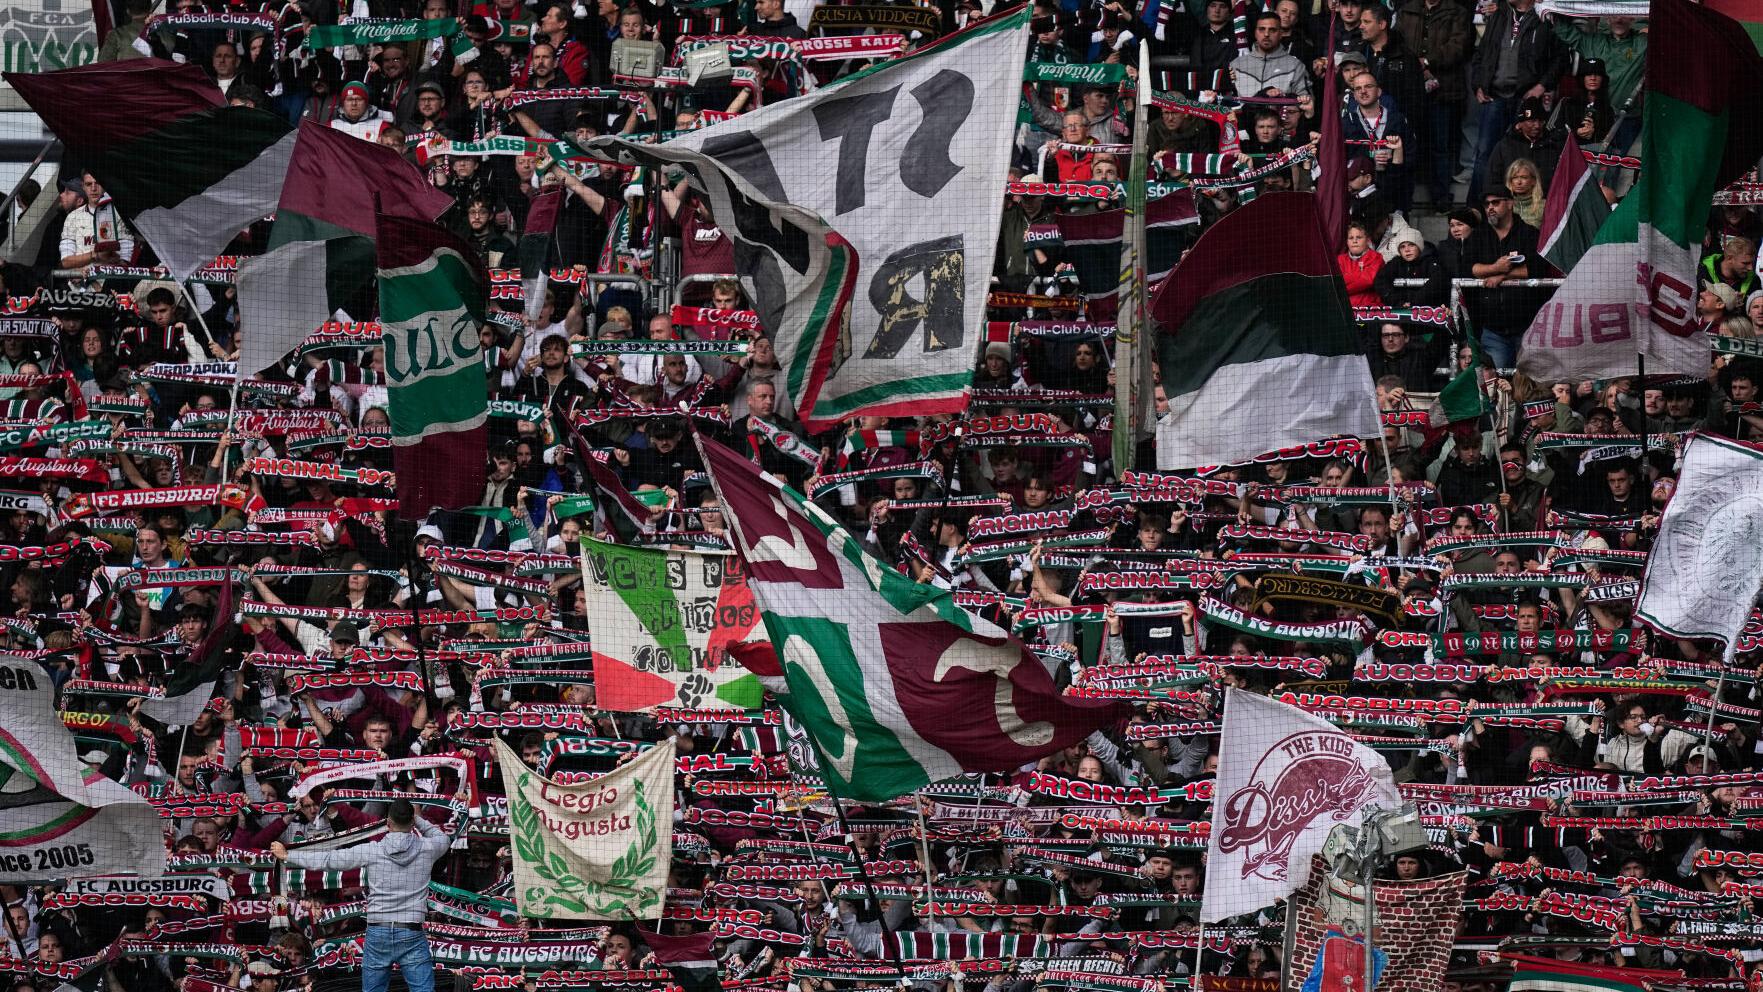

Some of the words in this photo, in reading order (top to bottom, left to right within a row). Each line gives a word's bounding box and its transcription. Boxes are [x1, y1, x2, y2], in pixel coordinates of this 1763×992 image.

[168, 14, 249, 26] Fußball-Club
[813, 9, 863, 21] GUSTA
[352, 21, 418, 41] Mitglied
[1037, 63, 1107, 83] Mitglied
[697, 309, 716, 323] FC
[14, 321, 41, 336] STADT
[203, 411, 229, 423] SIND
[982, 435, 1006, 447] DER
[9, 457, 89, 476] Augsburg
[97, 496, 120, 509] FC
[122, 487, 217, 507] AUGSBURG
[1334, 487, 1383, 498] AUGSBURG
[972, 544, 1000, 558] SIND
[519, 562, 545, 573] SIND
[548, 561, 573, 572] DER
[118, 573, 142, 587] FC
[245, 602, 270, 615] WIR
[271, 605, 301, 617] SIND
[302, 608, 329, 619] DER
[1023, 605, 1073, 626] SIND
[1075, 605, 1098, 621] 2.
[1249, 617, 1273, 632] FC
[1111, 677, 1138, 688] DER
[1277, 692, 1467, 712] AUGSBURG
[93, 713, 112, 726] 07
[1358, 712, 1374, 724] FC
[1280, 738, 1317, 760] THE
[1316, 734, 1355, 759] KIDS
[1029, 770, 1170, 805] ORIGINAL
[540, 782, 618, 815] Legio
[532, 805, 632, 842] Augusta
[1061, 813, 1172, 833] ORIGINAL
[1102, 832, 1128, 844] SIND
[1131, 833, 1156, 846] DER
[1173, 835, 1190, 847] FC
[35, 842, 95, 871] 2005
[185, 853, 212, 865] SIND
[215, 852, 241, 864] DER
[731, 864, 854, 881] ORIGINAL
[77, 880, 99, 895] FC
[107, 878, 215, 895] AUGSBURG
[882, 884, 908, 897] DER
[916, 901, 1115, 918] AUGSBURG
[470, 944, 495, 962] FC
[497, 941, 600, 964] AUGSBURG
[1047, 958, 1083, 973] GEGEN
[1093, 974, 1138, 989] AUGSBURG
